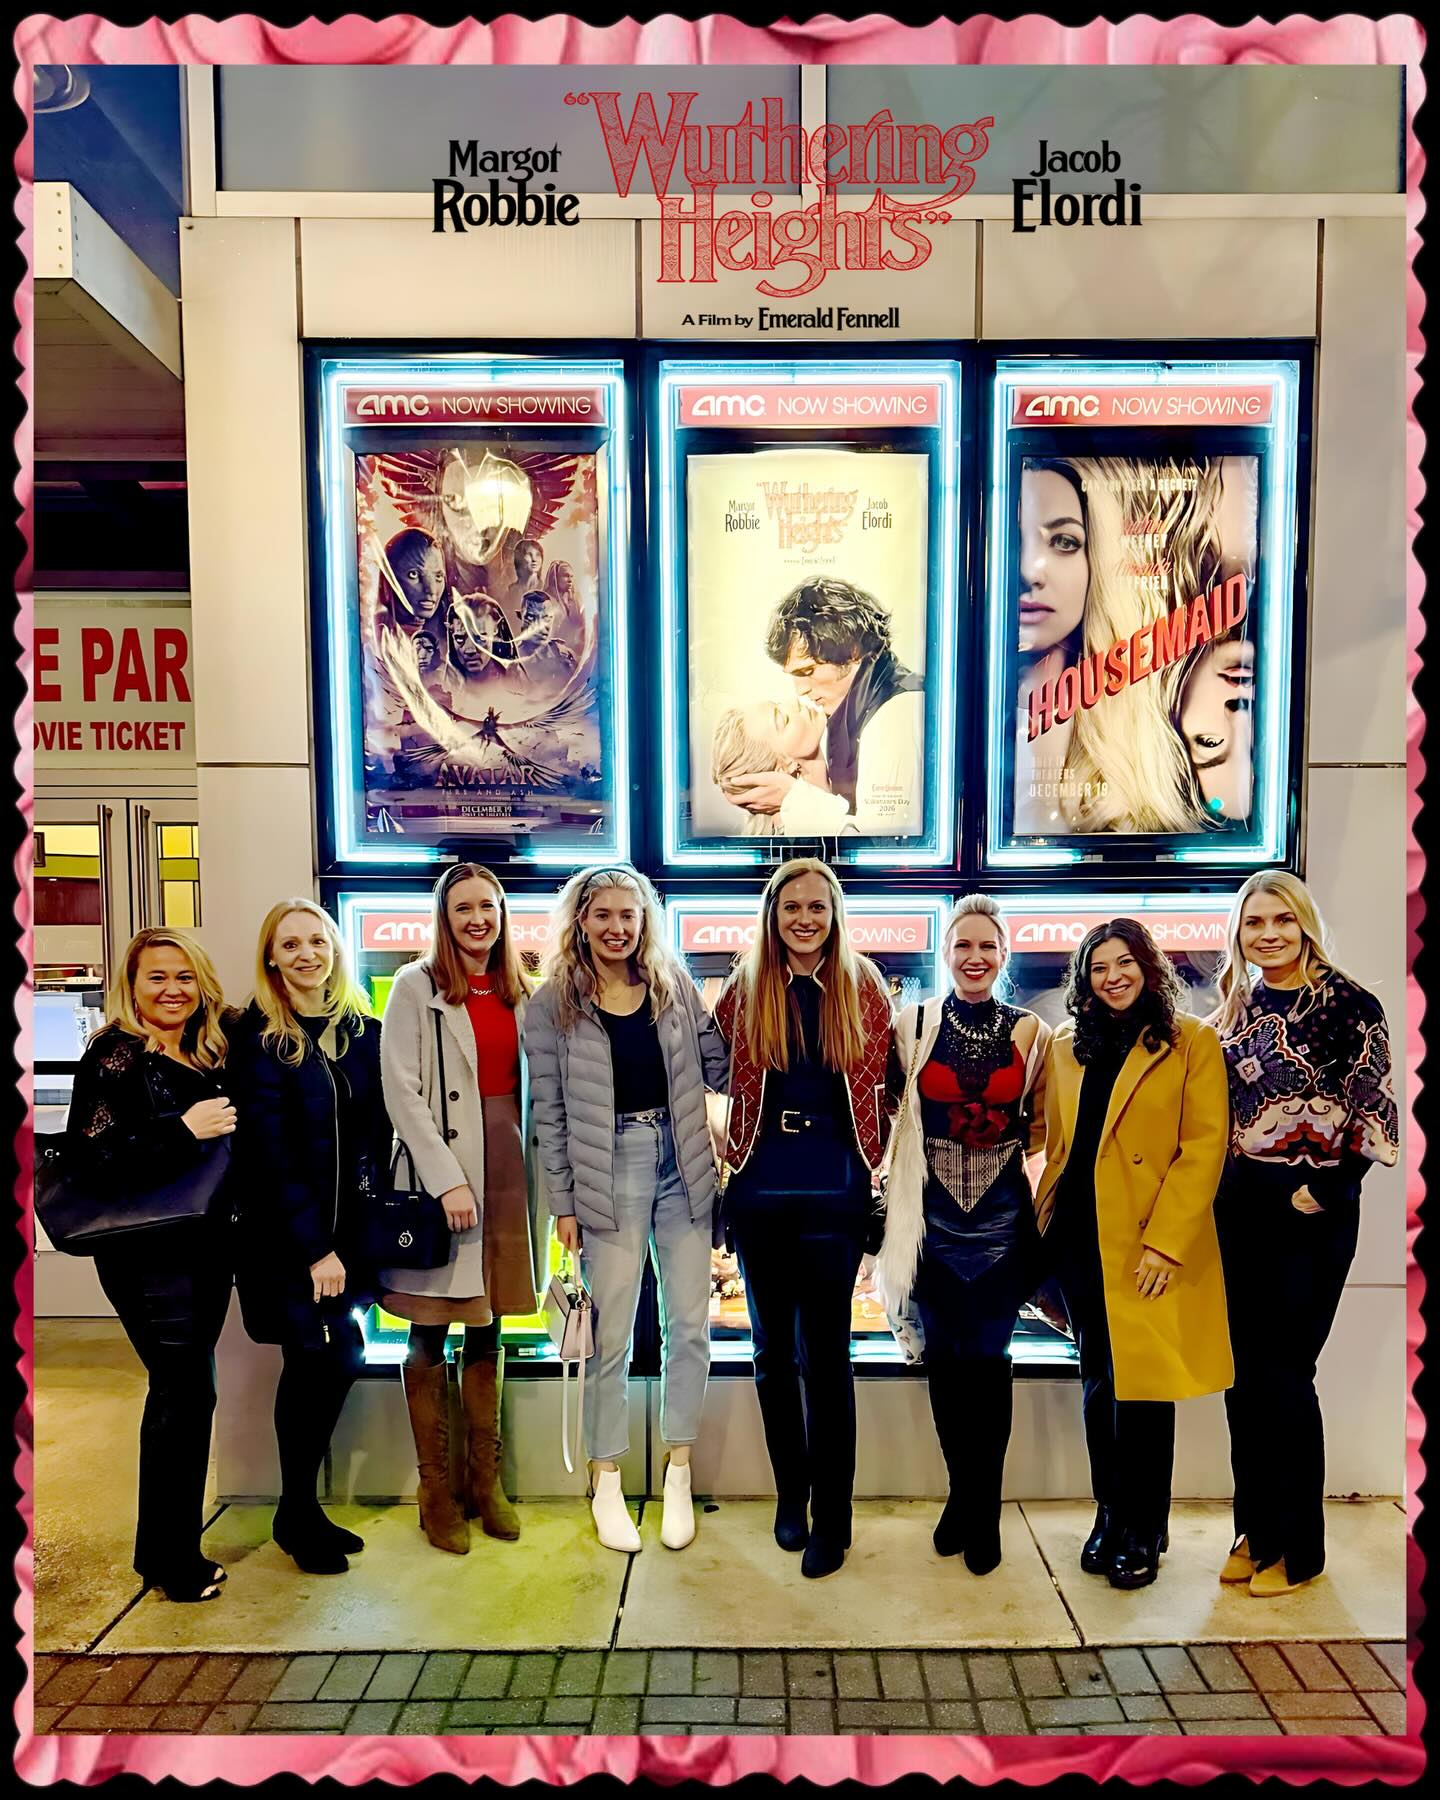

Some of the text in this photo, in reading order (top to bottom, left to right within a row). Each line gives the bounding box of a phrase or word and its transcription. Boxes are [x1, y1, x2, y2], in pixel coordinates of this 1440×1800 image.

[442, 397, 495, 414] NOW
[496, 396, 592, 415] SHOWING
[777, 397, 831, 415] NOW
[832, 396, 928, 415] SHOWING
[1111, 396, 1162, 415] NOW
[1165, 396, 1262, 415] SHOWING
[866, 497, 889, 511] Jacob
[725, 513, 761, 533] Robbie
[862, 511, 893, 530] Elordi
[1028, 573, 1249, 743] HOUSEMAID
[90, 722, 186, 751] TICKET
[434, 762, 540, 787] AVATAR
[1029, 782, 1109, 798] DECEMBER 19
[461, 805, 502, 813] DECEMBER
[847, 927, 917, 944] OWING
[1152, 922, 1226, 940] SHOWIN
